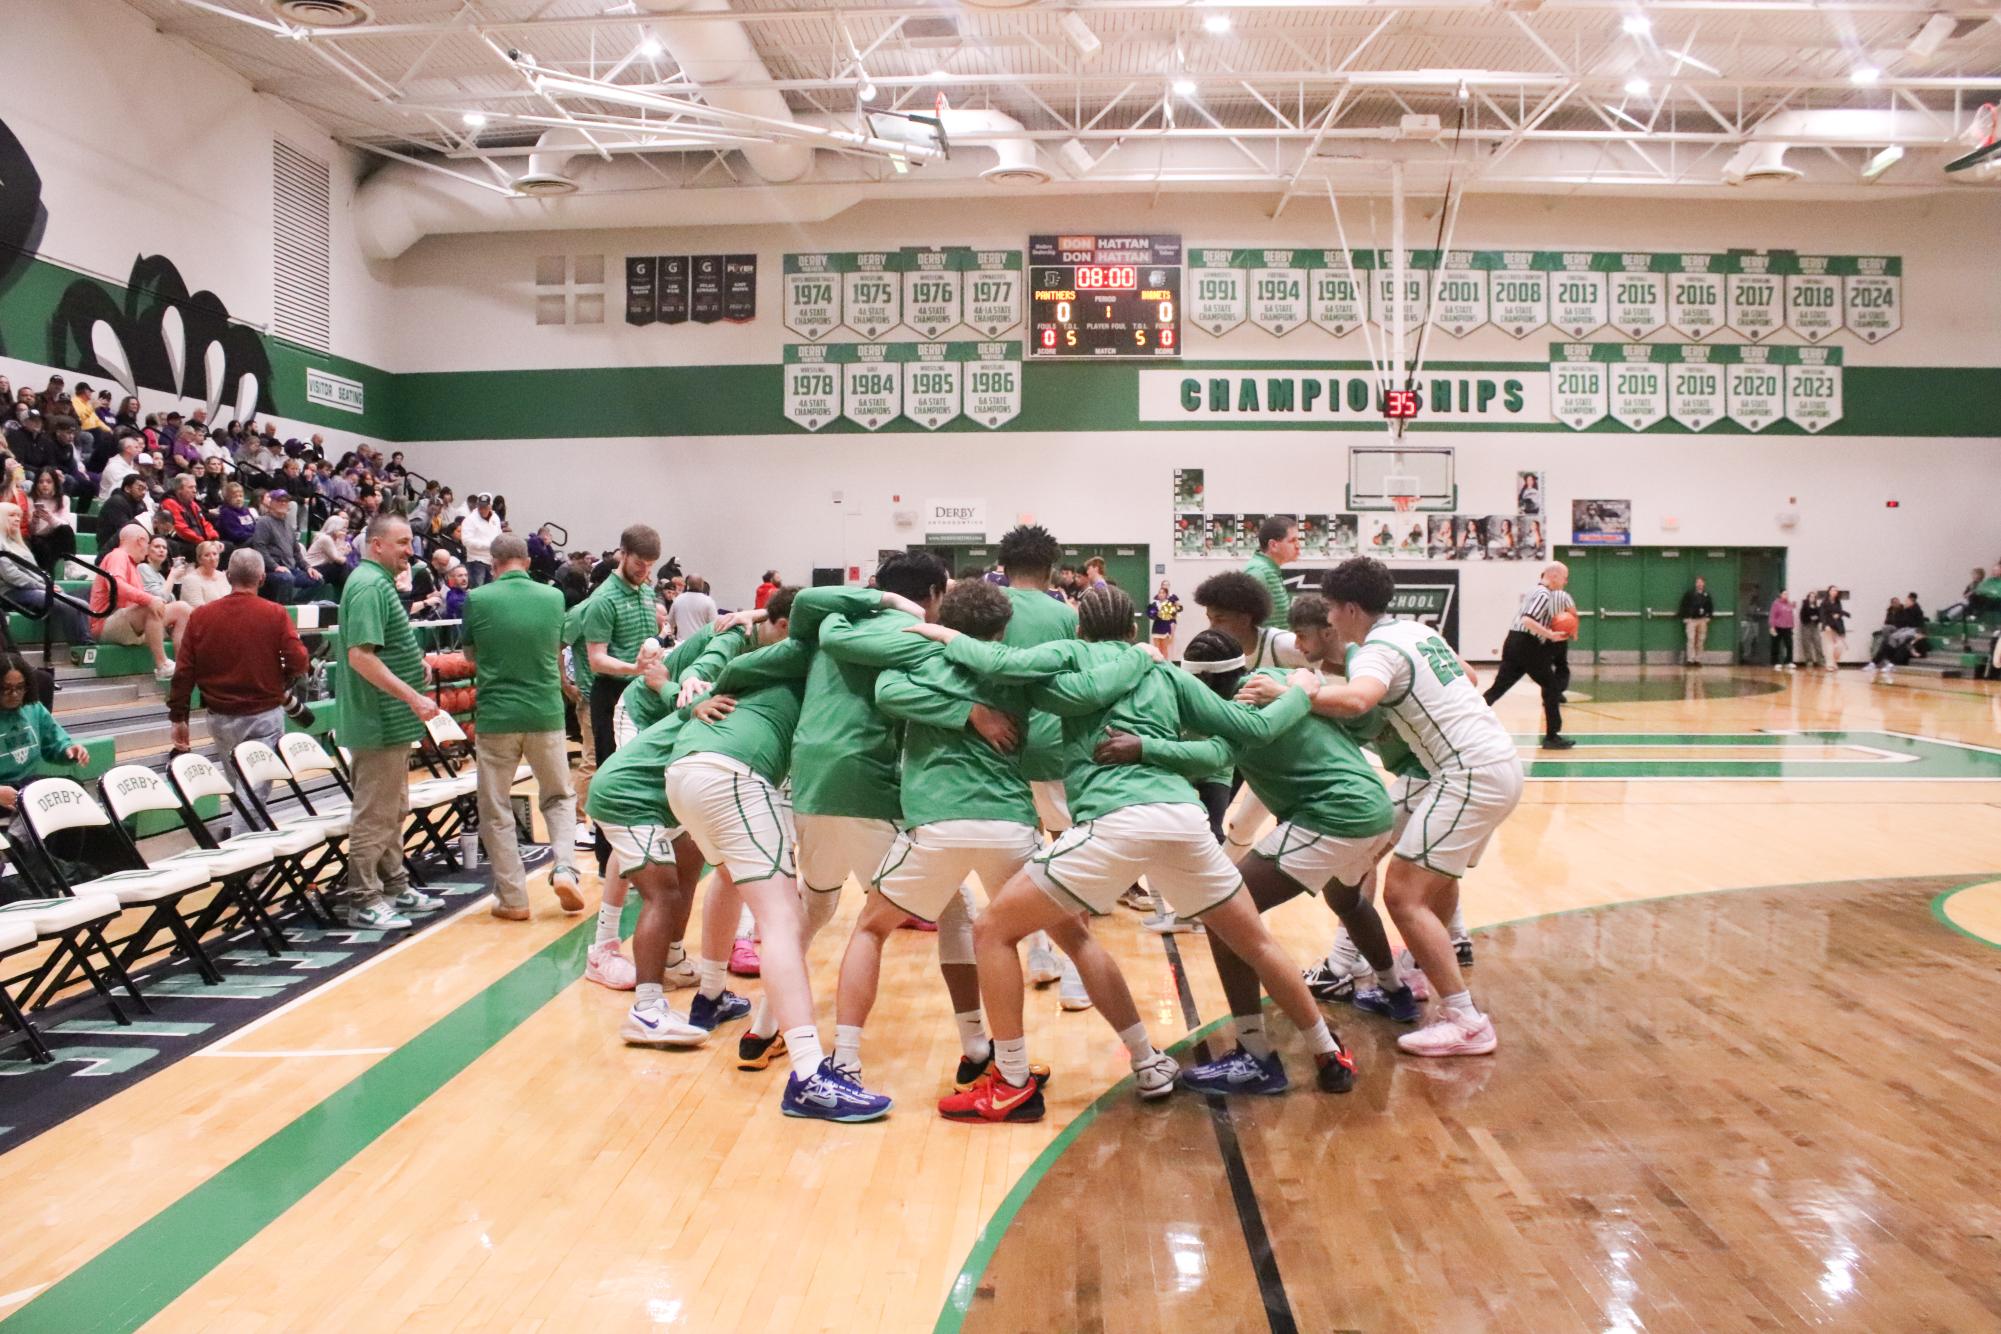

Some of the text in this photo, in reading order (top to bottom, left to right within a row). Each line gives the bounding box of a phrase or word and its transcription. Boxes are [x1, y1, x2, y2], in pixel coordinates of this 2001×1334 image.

[1063, 238, 1149, 249] DON HATTAN
[1062, 252, 1150, 262] DON HATTAN
[1078, 268, 1133, 287] 08:00
[794, 285, 832, 305] 1974
[853, 284, 891, 303] 1975
[913, 283, 952, 303] 1976
[973, 282, 1011, 302] 1977
[1035, 291, 1076, 300] PANTHERS
[1199, 280, 1236, 300] 1991
[1258, 281, 1299, 300] 1994
[1439, 282, 1479, 301] 2001
[1496, 283, 1541, 302] 2008
[1559, 284, 1597, 303] 2013
[1617, 284, 1656, 304] 2015
[1676, 285, 1716, 304] 2016
[1736, 286, 1774, 305] 2017
[1793, 287, 1833, 307] 2018
[1851, 288, 1893, 307] 2024
[795, 317, 831, 325] CHAMPIONS
[914, 315, 950, 323] CHAMPIONS
[1057, 302, 1070, 322] 0
[1159, 302, 1173, 322] 0
[1044, 330, 1055, 346] 0
[1161, 330, 1173, 346] 0
[308, 379, 363, 405] VISITOR SEATING
[793, 375, 833, 395] 1978
[851, 374, 893, 394] 1984
[913, 374, 953, 394] 1985
[972, 373, 1014, 393] 1986
[1558, 374, 1598, 394] 2018
[1618, 375, 1656, 394] 2019
[1677, 375, 1715, 395] 2019
[1734, 376, 1776, 395] 2020
[1793, 377, 1833, 397] 2023
[795, 408, 831, 416] CHAMPIONS
[855, 407, 890, 415] CHAMPIONS
[1389, 392, 1415, 415] 35
[1387, 595, 1435, 608] CHOOL
[289, 741, 317, 756] DERBY
[246, 751, 274, 767] DERBY
[183, 763, 214, 782] DERBY
[116, 776, 159, 796] DERBY
[37, 790, 84, 812] DERBY
